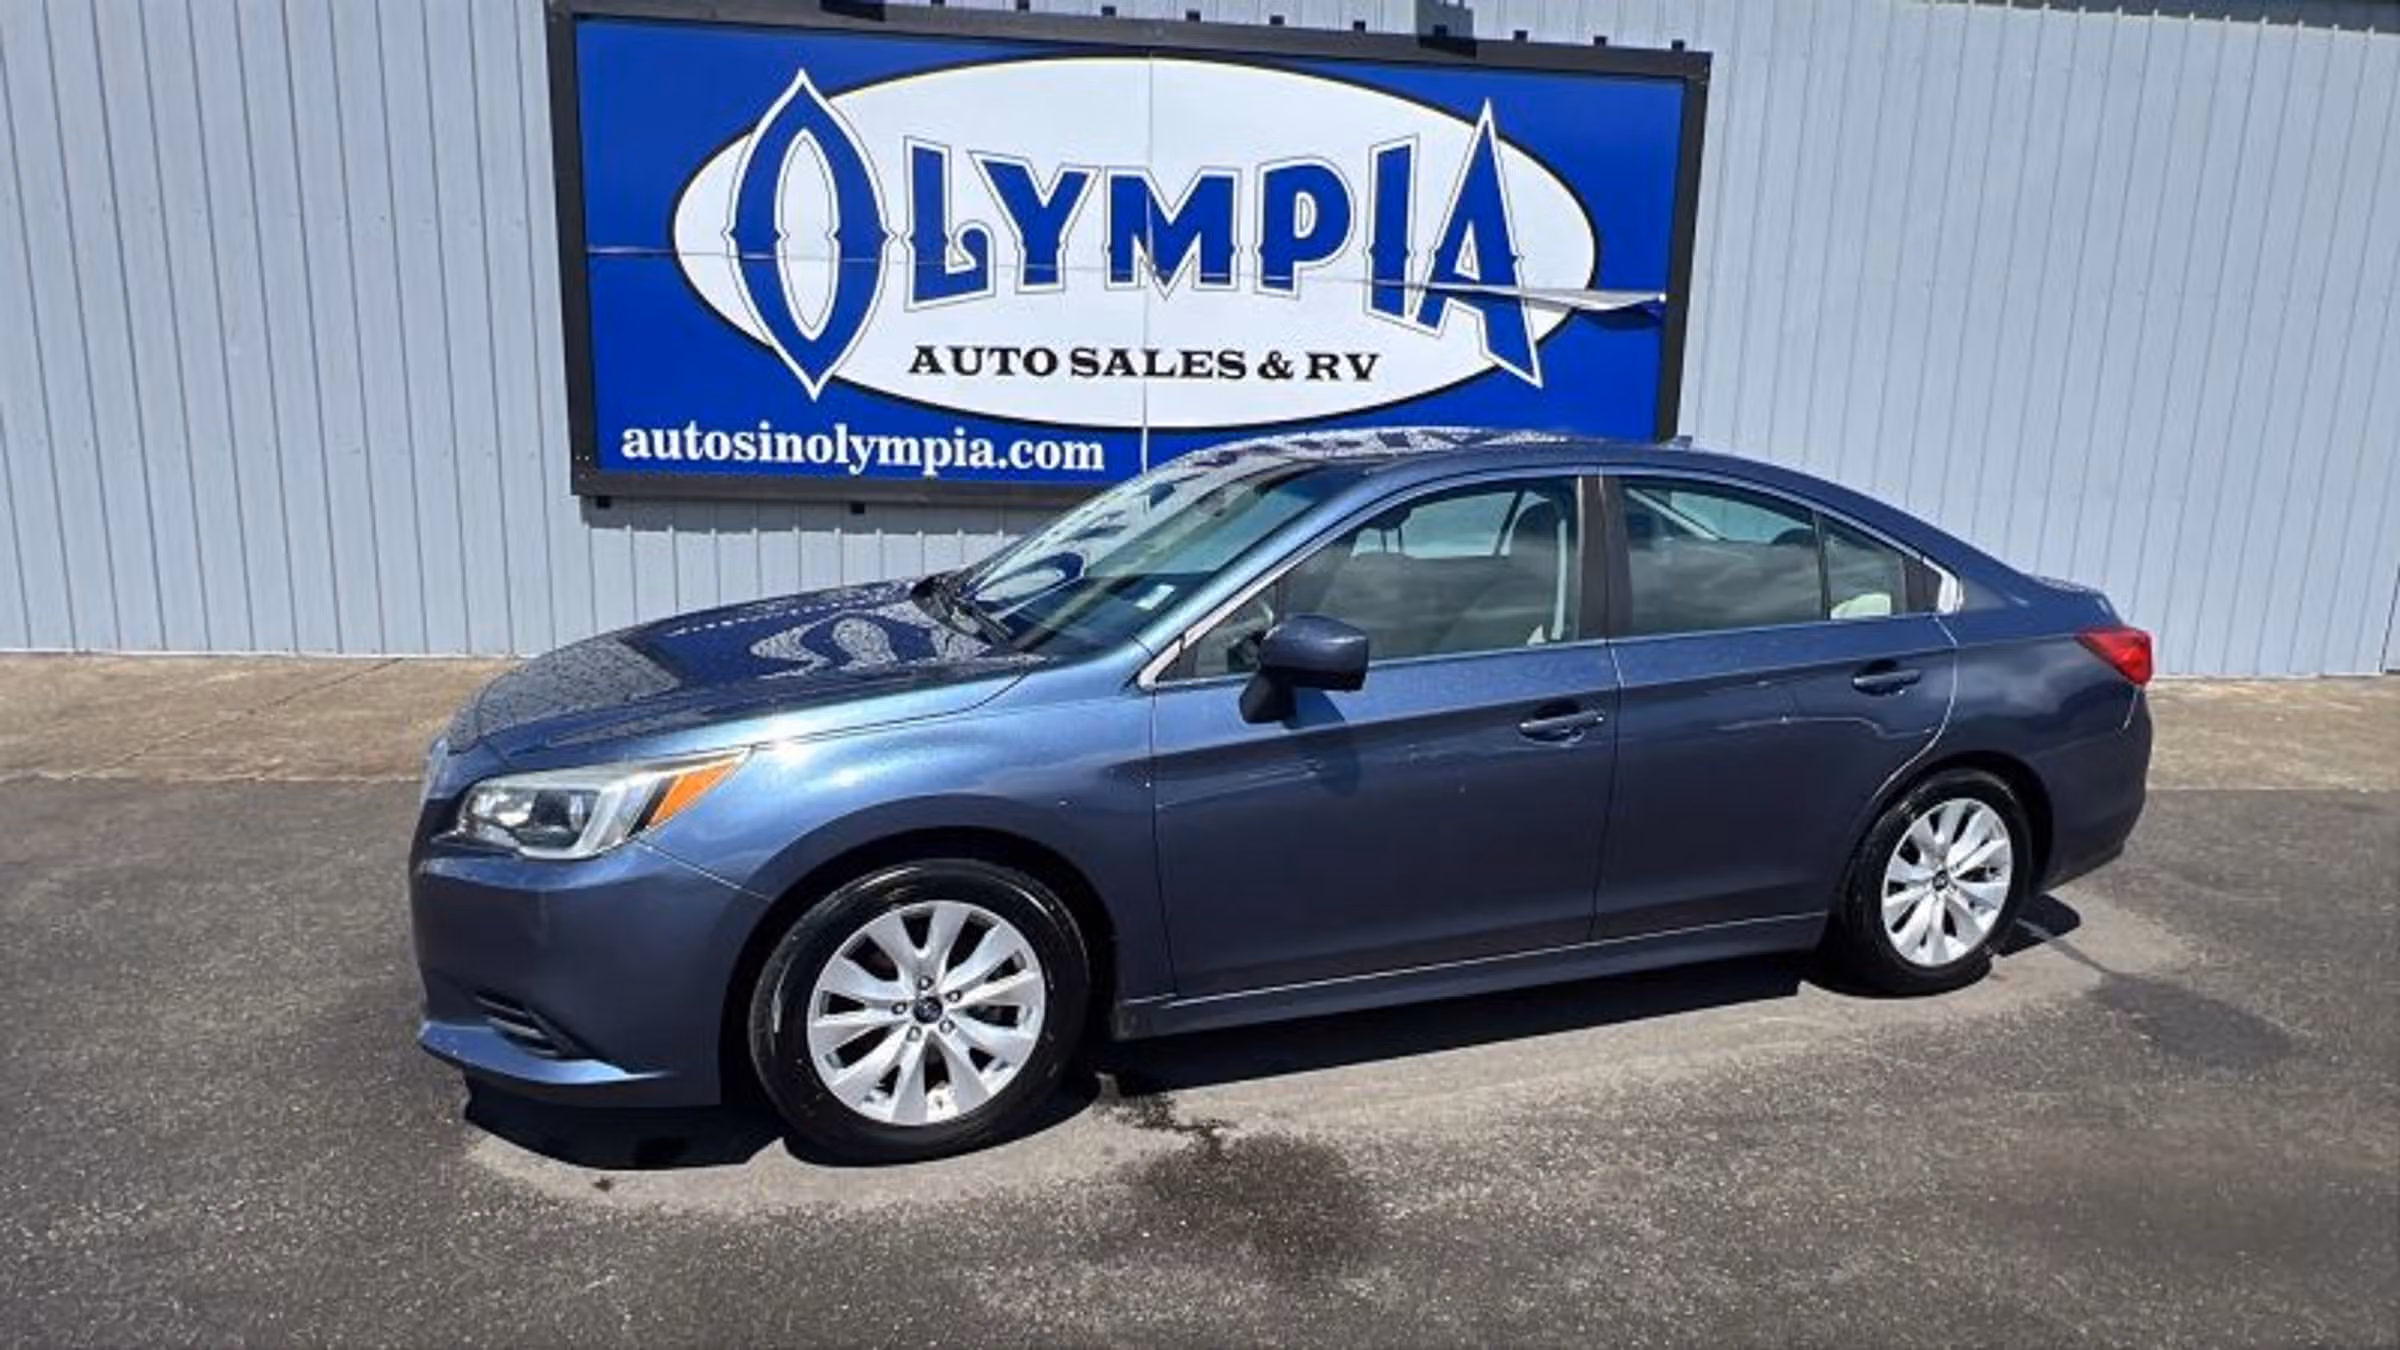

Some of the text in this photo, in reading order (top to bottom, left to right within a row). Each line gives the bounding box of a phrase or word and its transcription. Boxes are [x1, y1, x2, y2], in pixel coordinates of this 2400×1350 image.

[724, 67, 1542, 400] OLYMPIA
[909, 345, 1380, 381] AUTO SALES & RV
[621, 422, 1105, 477] autosinolympia.com
